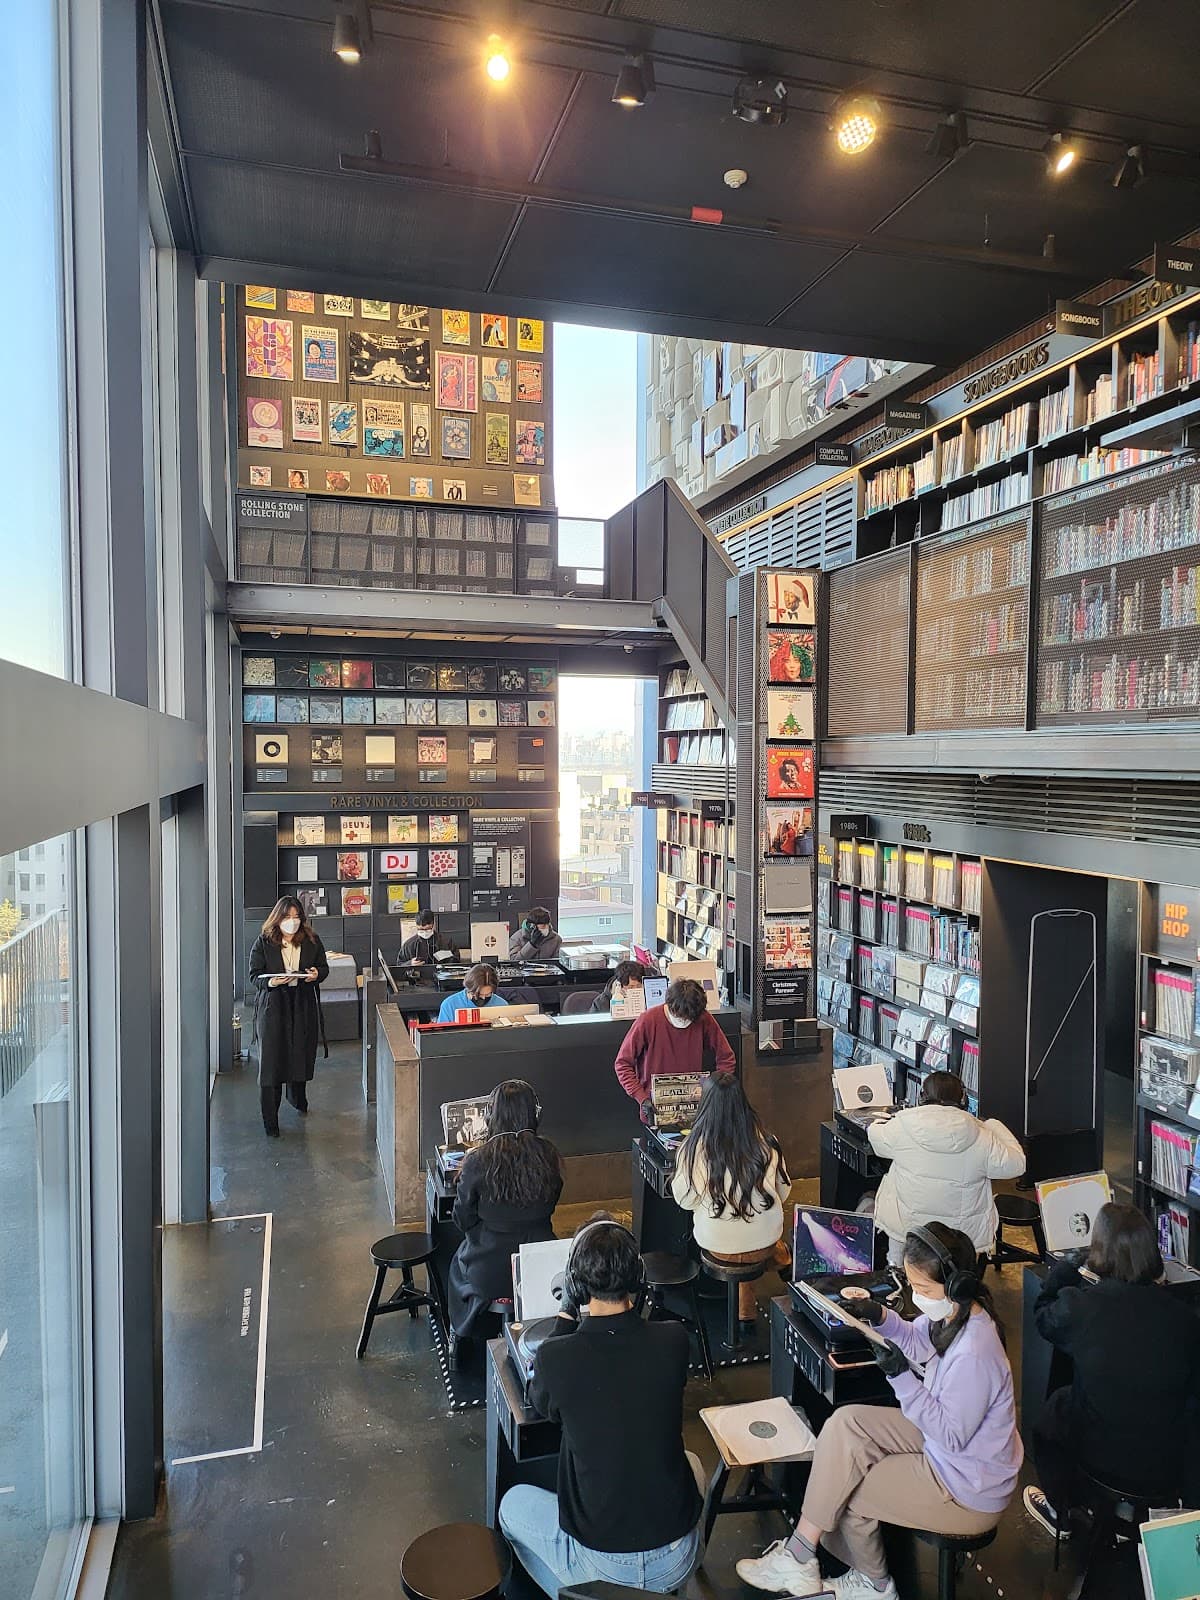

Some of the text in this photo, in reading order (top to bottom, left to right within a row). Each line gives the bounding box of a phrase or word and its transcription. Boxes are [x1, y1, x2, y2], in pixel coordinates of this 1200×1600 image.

[1167, 259, 1194, 272] THEORY
[1060, 312, 1100, 326] SONGBOOKS
[963, 342, 1050, 403] SONGBOOKS
[889, 411, 921, 420] MAGAZINES
[819, 447, 844, 455] COMPLETE
[819, 454, 849, 462] COLLECTION
[241, 500, 305, 512] ROLLING STONE
[241, 508, 291, 519] COLLECTION
[330, 796, 482, 808] RARE VINYL & COLLECTION
[839, 822, 858, 830] 1980s
[902, 822, 932, 842] 1980s
[387, 855, 409, 869] DJ
[1165, 903, 1188, 920] HIP
[1162, 919, 1190, 937] HOP
